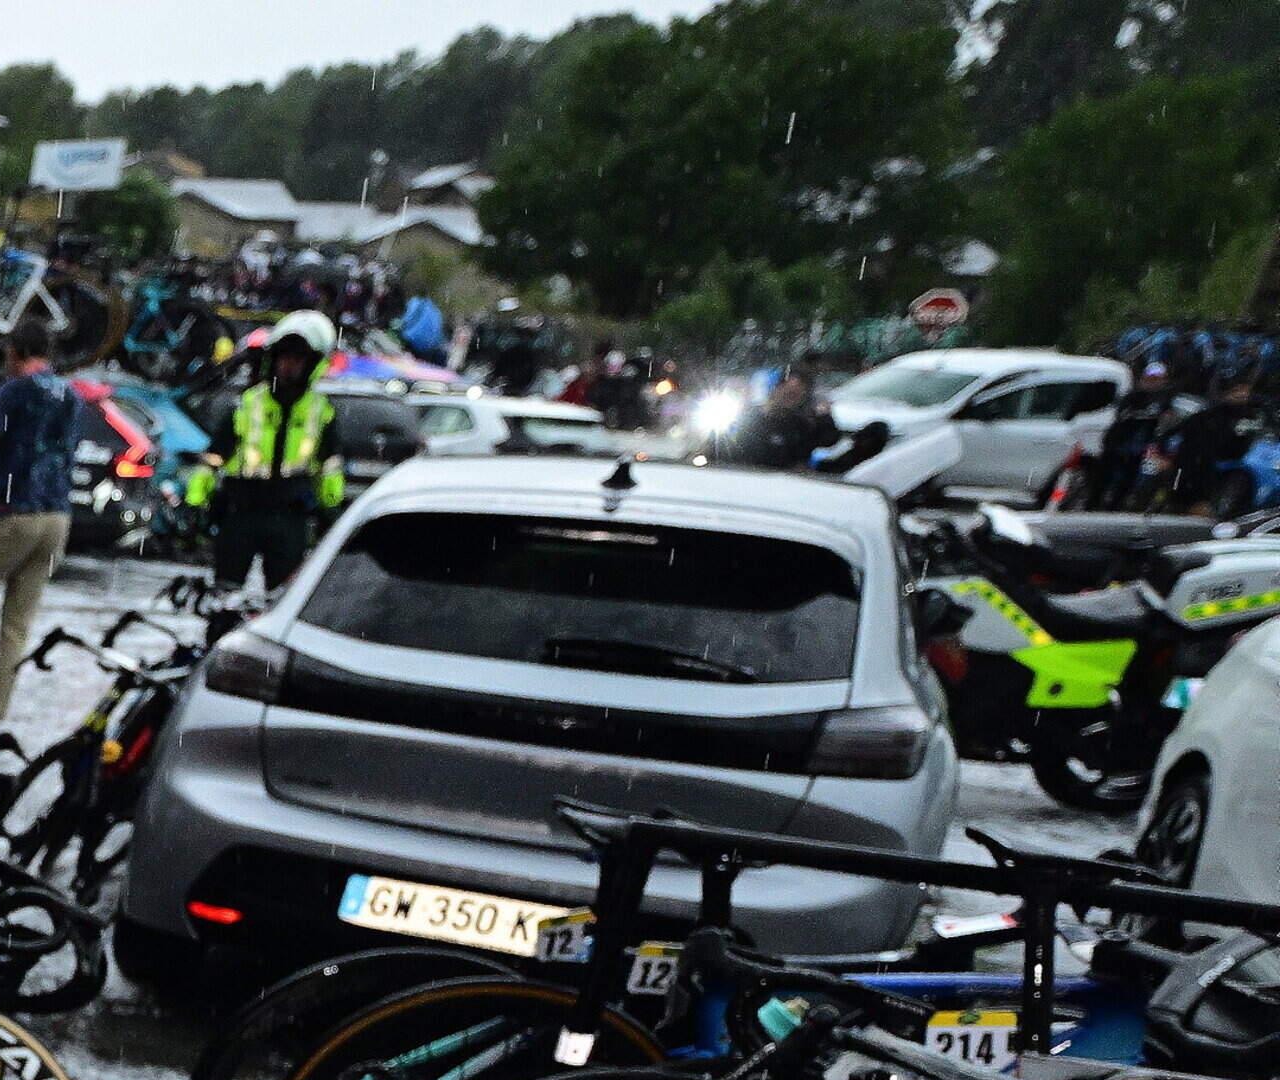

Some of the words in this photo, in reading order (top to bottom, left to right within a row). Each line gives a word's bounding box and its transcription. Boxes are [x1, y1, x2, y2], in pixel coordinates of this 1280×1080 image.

[369, 885, 419, 919] GW
[427, 897, 500, 936] 350
[509, 909, 538, 942] K
[935, 1031, 996, 1065] 214
